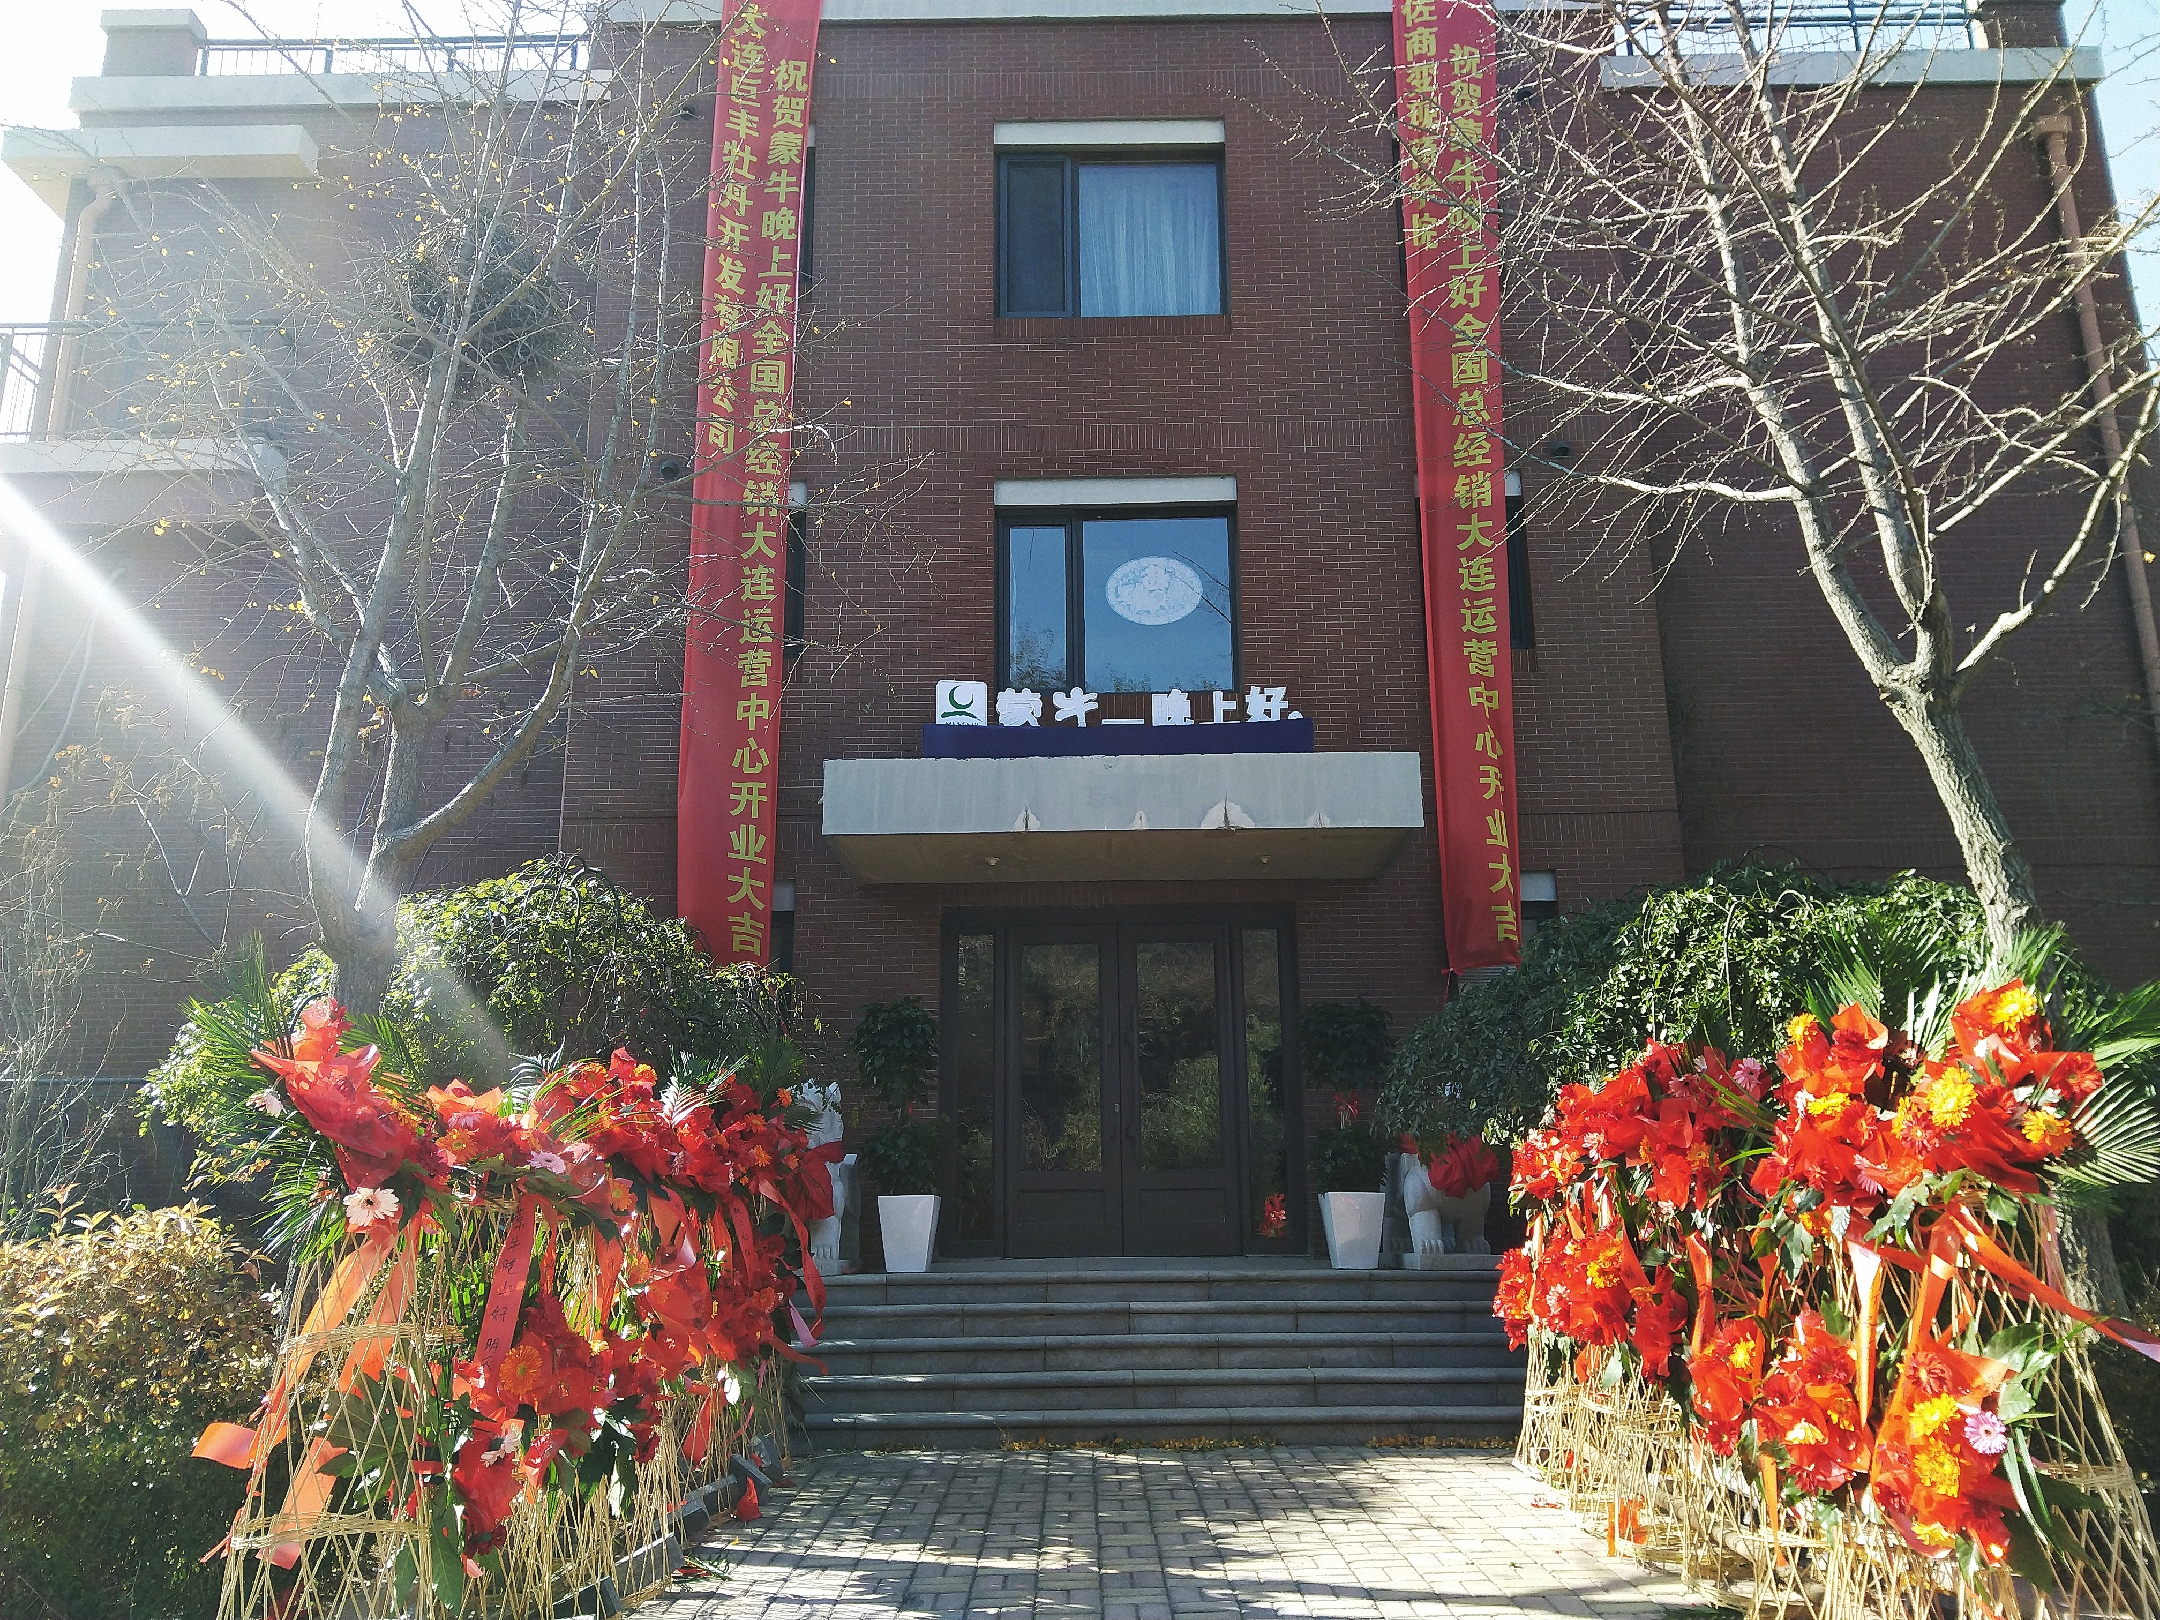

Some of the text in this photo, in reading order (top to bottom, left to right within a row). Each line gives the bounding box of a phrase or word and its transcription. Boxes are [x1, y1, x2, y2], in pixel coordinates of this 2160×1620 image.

[726, 59, 809, 956] 祝贺蒙牛晚上好全国总经销大连运营中心开业大吉
